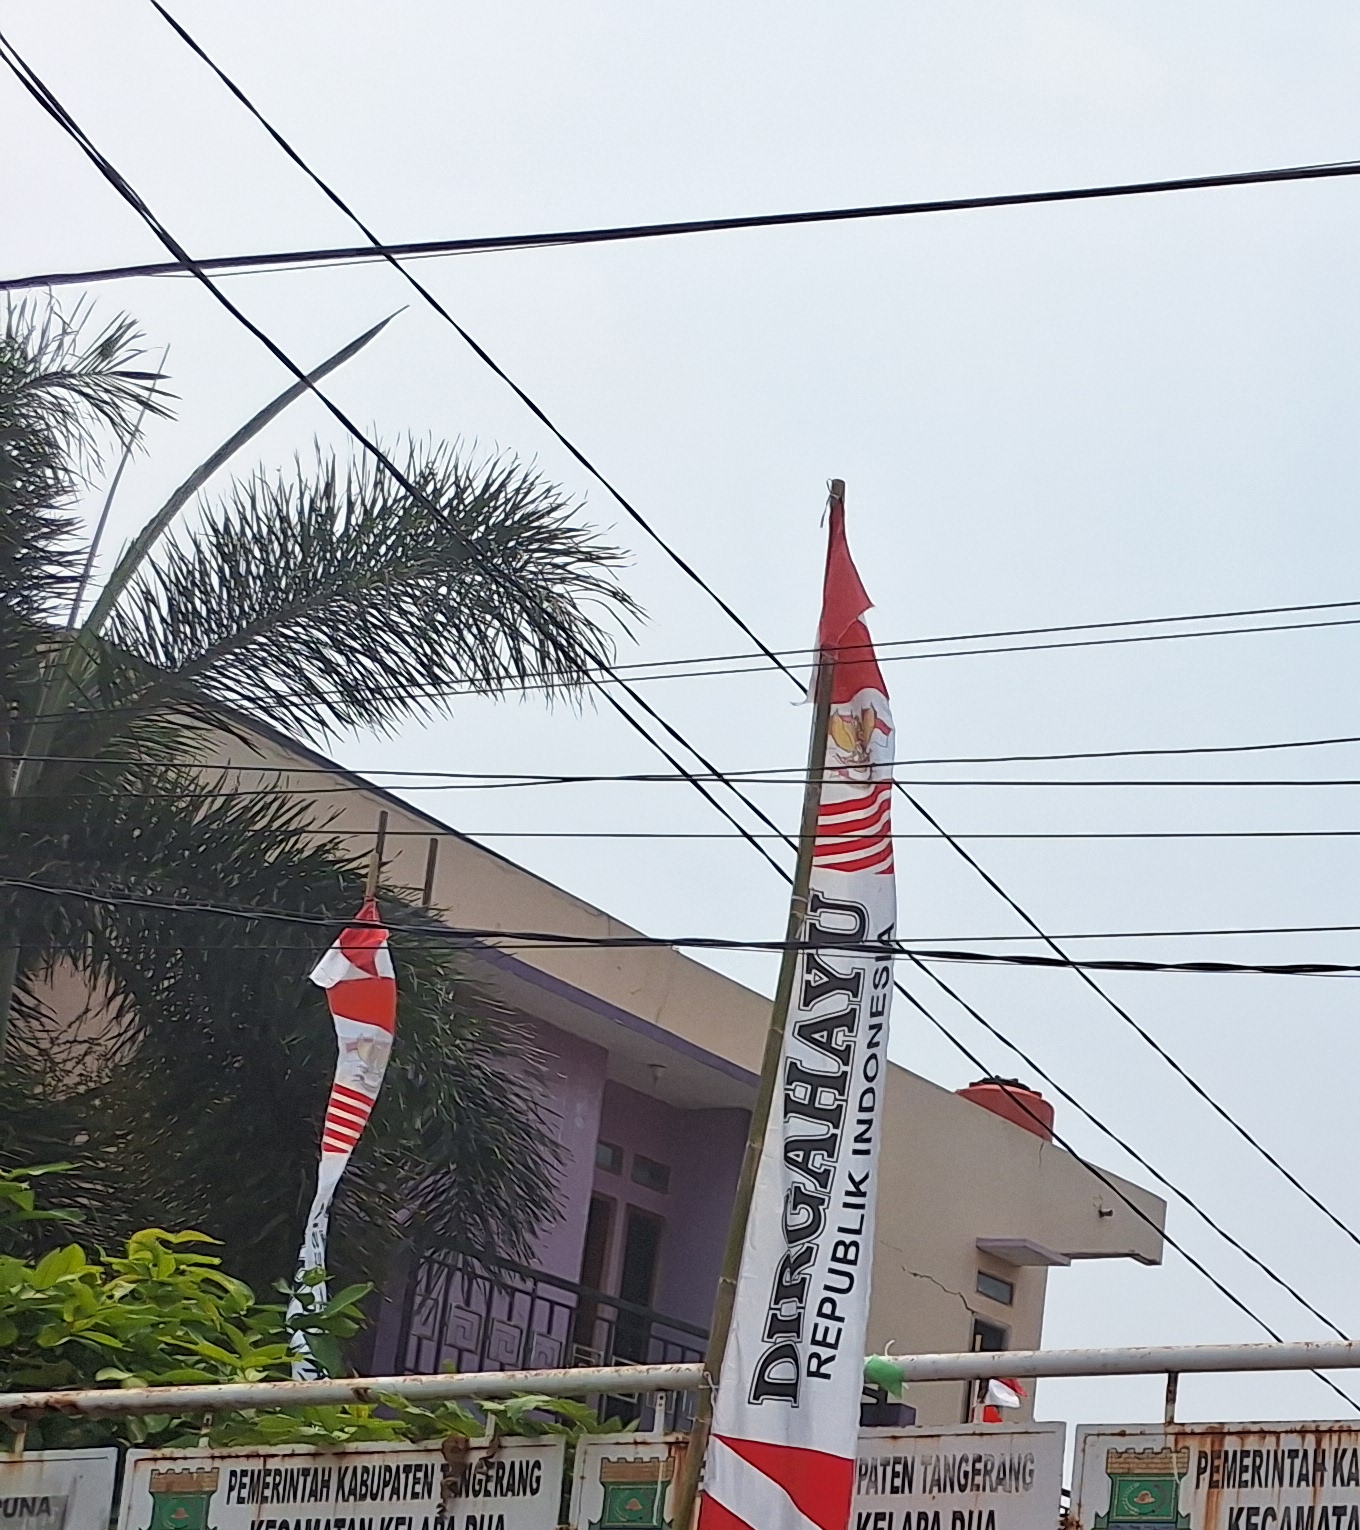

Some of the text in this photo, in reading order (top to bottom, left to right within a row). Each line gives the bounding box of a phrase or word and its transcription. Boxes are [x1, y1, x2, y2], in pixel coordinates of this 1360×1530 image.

[749, 889, 869, 1405] DIRGAHAYU
[807, 921, 895, 1381] REPUBLIK INDONESIA
[226, 1466, 331, 1505] PEMERINTAH
[337, 1463, 435, 1502] KABUPATEN
[855, 1452, 1034, 1496] PATEN TANGERANG
[1195, 1447, 1326, 1491] PEMERINTAH
